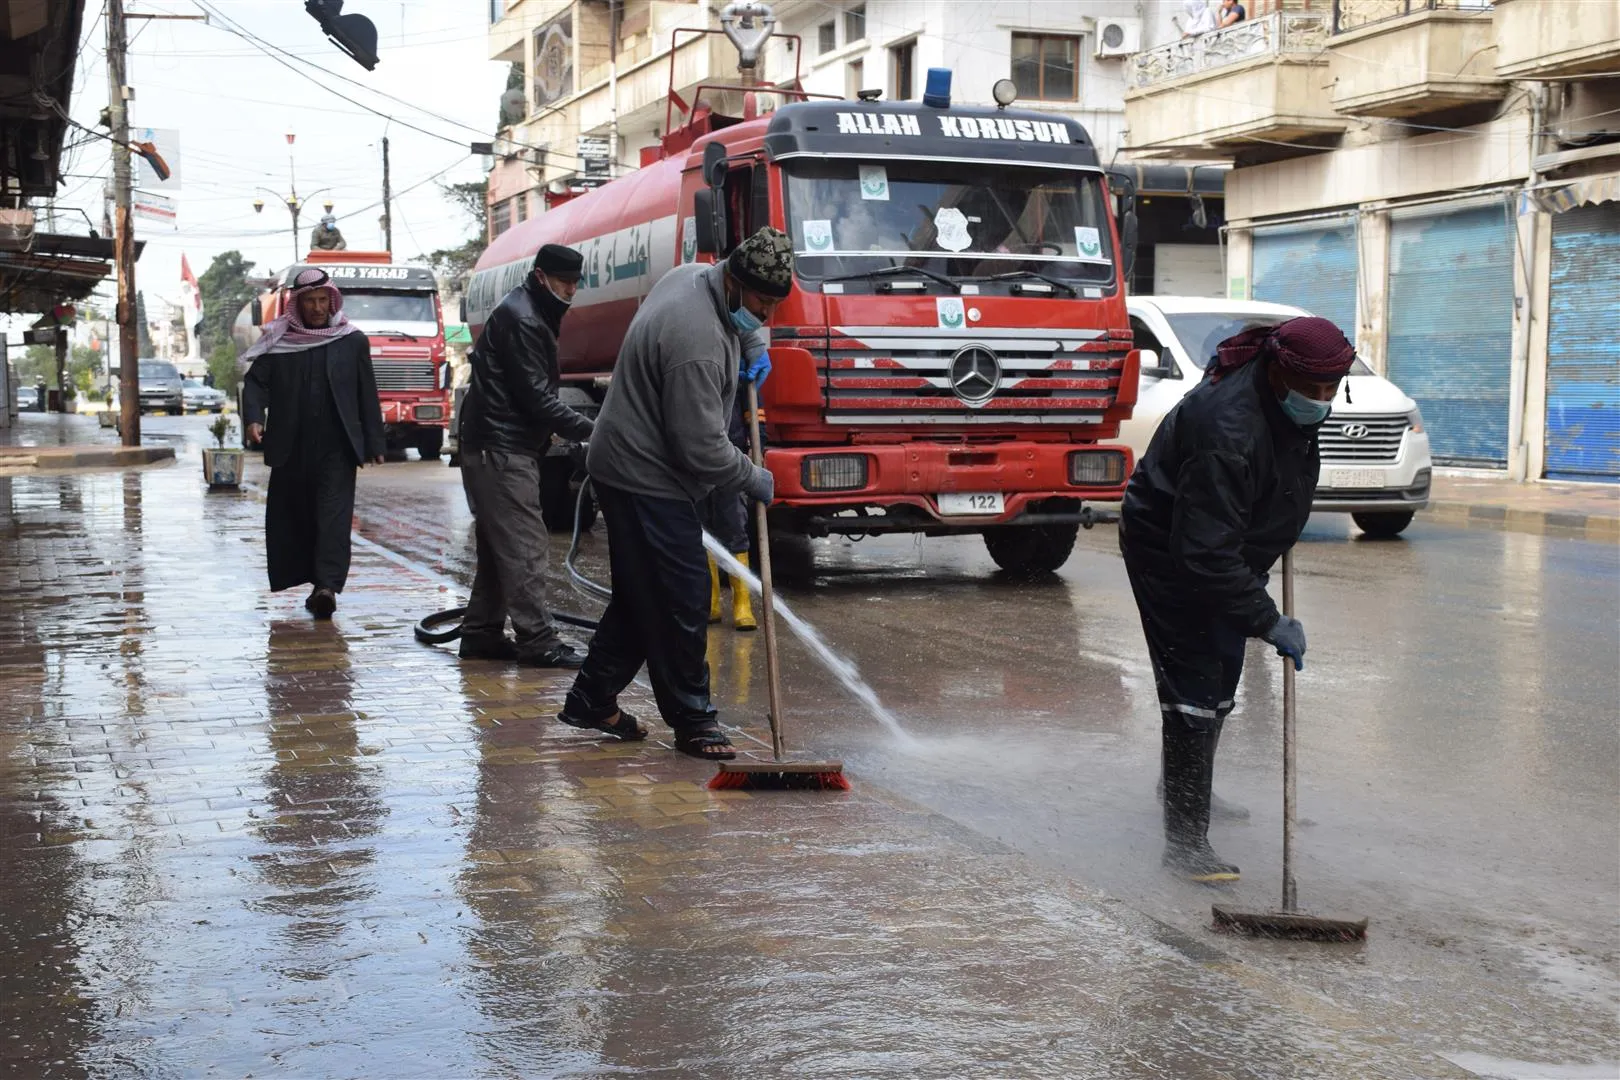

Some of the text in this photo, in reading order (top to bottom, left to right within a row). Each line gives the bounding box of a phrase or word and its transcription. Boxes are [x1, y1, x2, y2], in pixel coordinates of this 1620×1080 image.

[836, 112, 1071, 145] ALLAH KORUSUN
[359, 267, 409, 280] YARAB
[968, 495, 996, 509] 122
